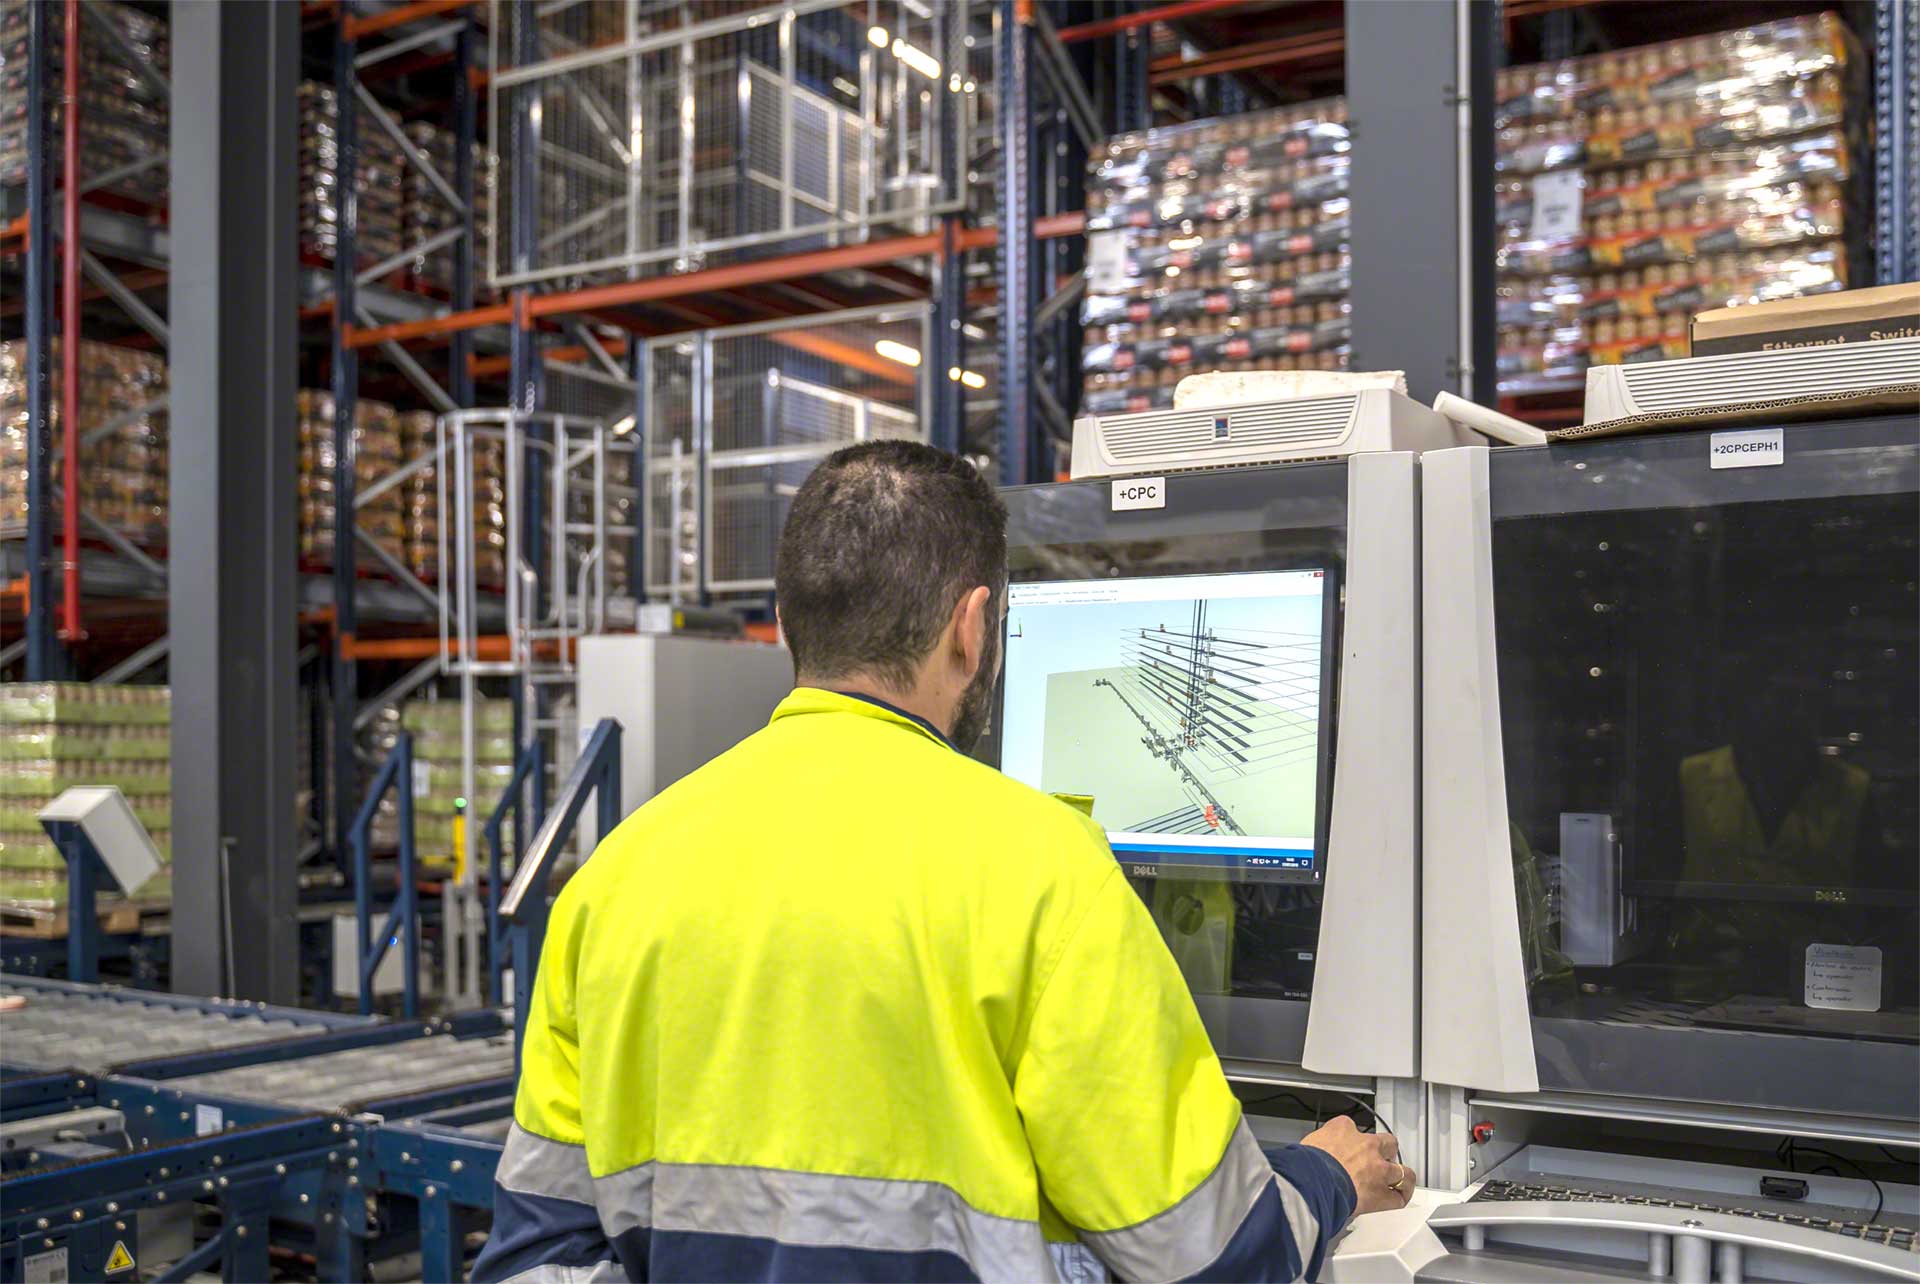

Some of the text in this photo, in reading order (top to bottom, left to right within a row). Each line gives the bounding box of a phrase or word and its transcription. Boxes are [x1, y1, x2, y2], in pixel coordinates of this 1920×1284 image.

[1713, 442, 1779, 455] +2CPCEPH1
[1119, 486, 1156, 500] +CPC
[1133, 865, 1158, 876] DELL
